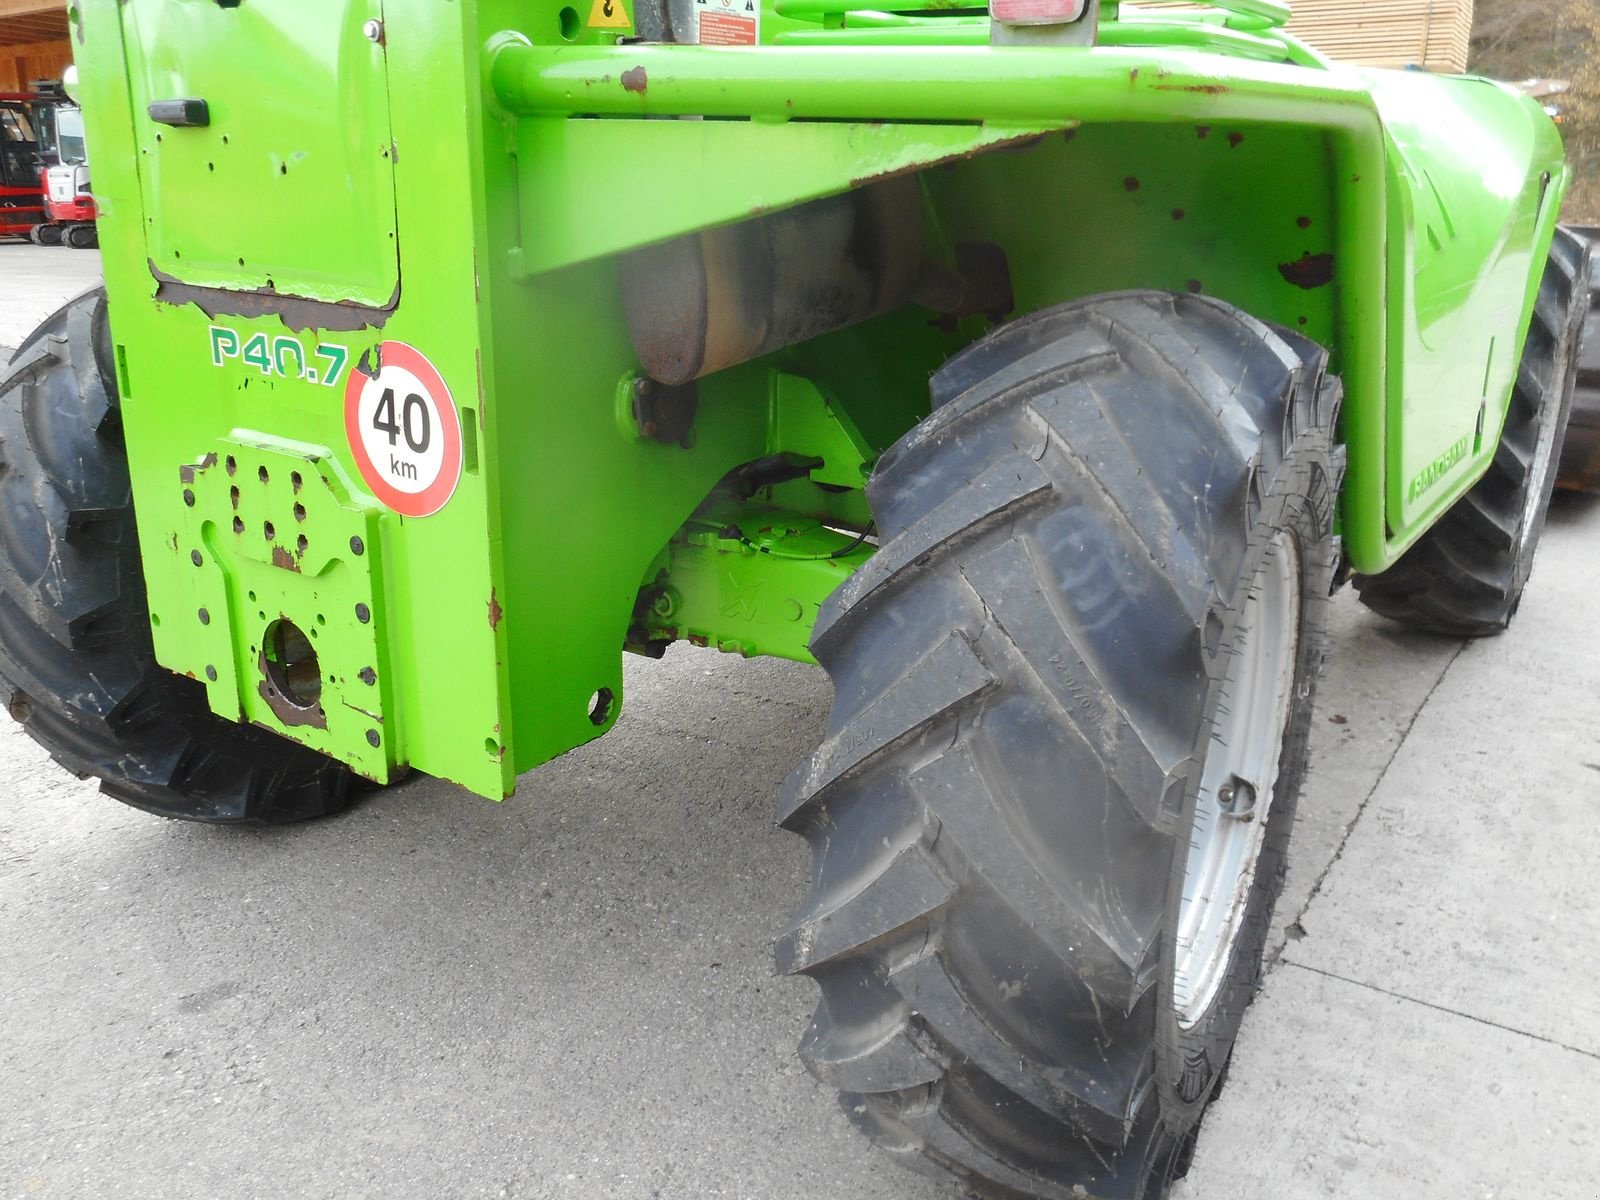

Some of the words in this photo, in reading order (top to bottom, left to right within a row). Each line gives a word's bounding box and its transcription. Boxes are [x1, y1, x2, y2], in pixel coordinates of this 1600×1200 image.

[208, 324, 349, 386] P40.7
[373, 387, 430, 454] 40
[390, 453, 418, 481] km
